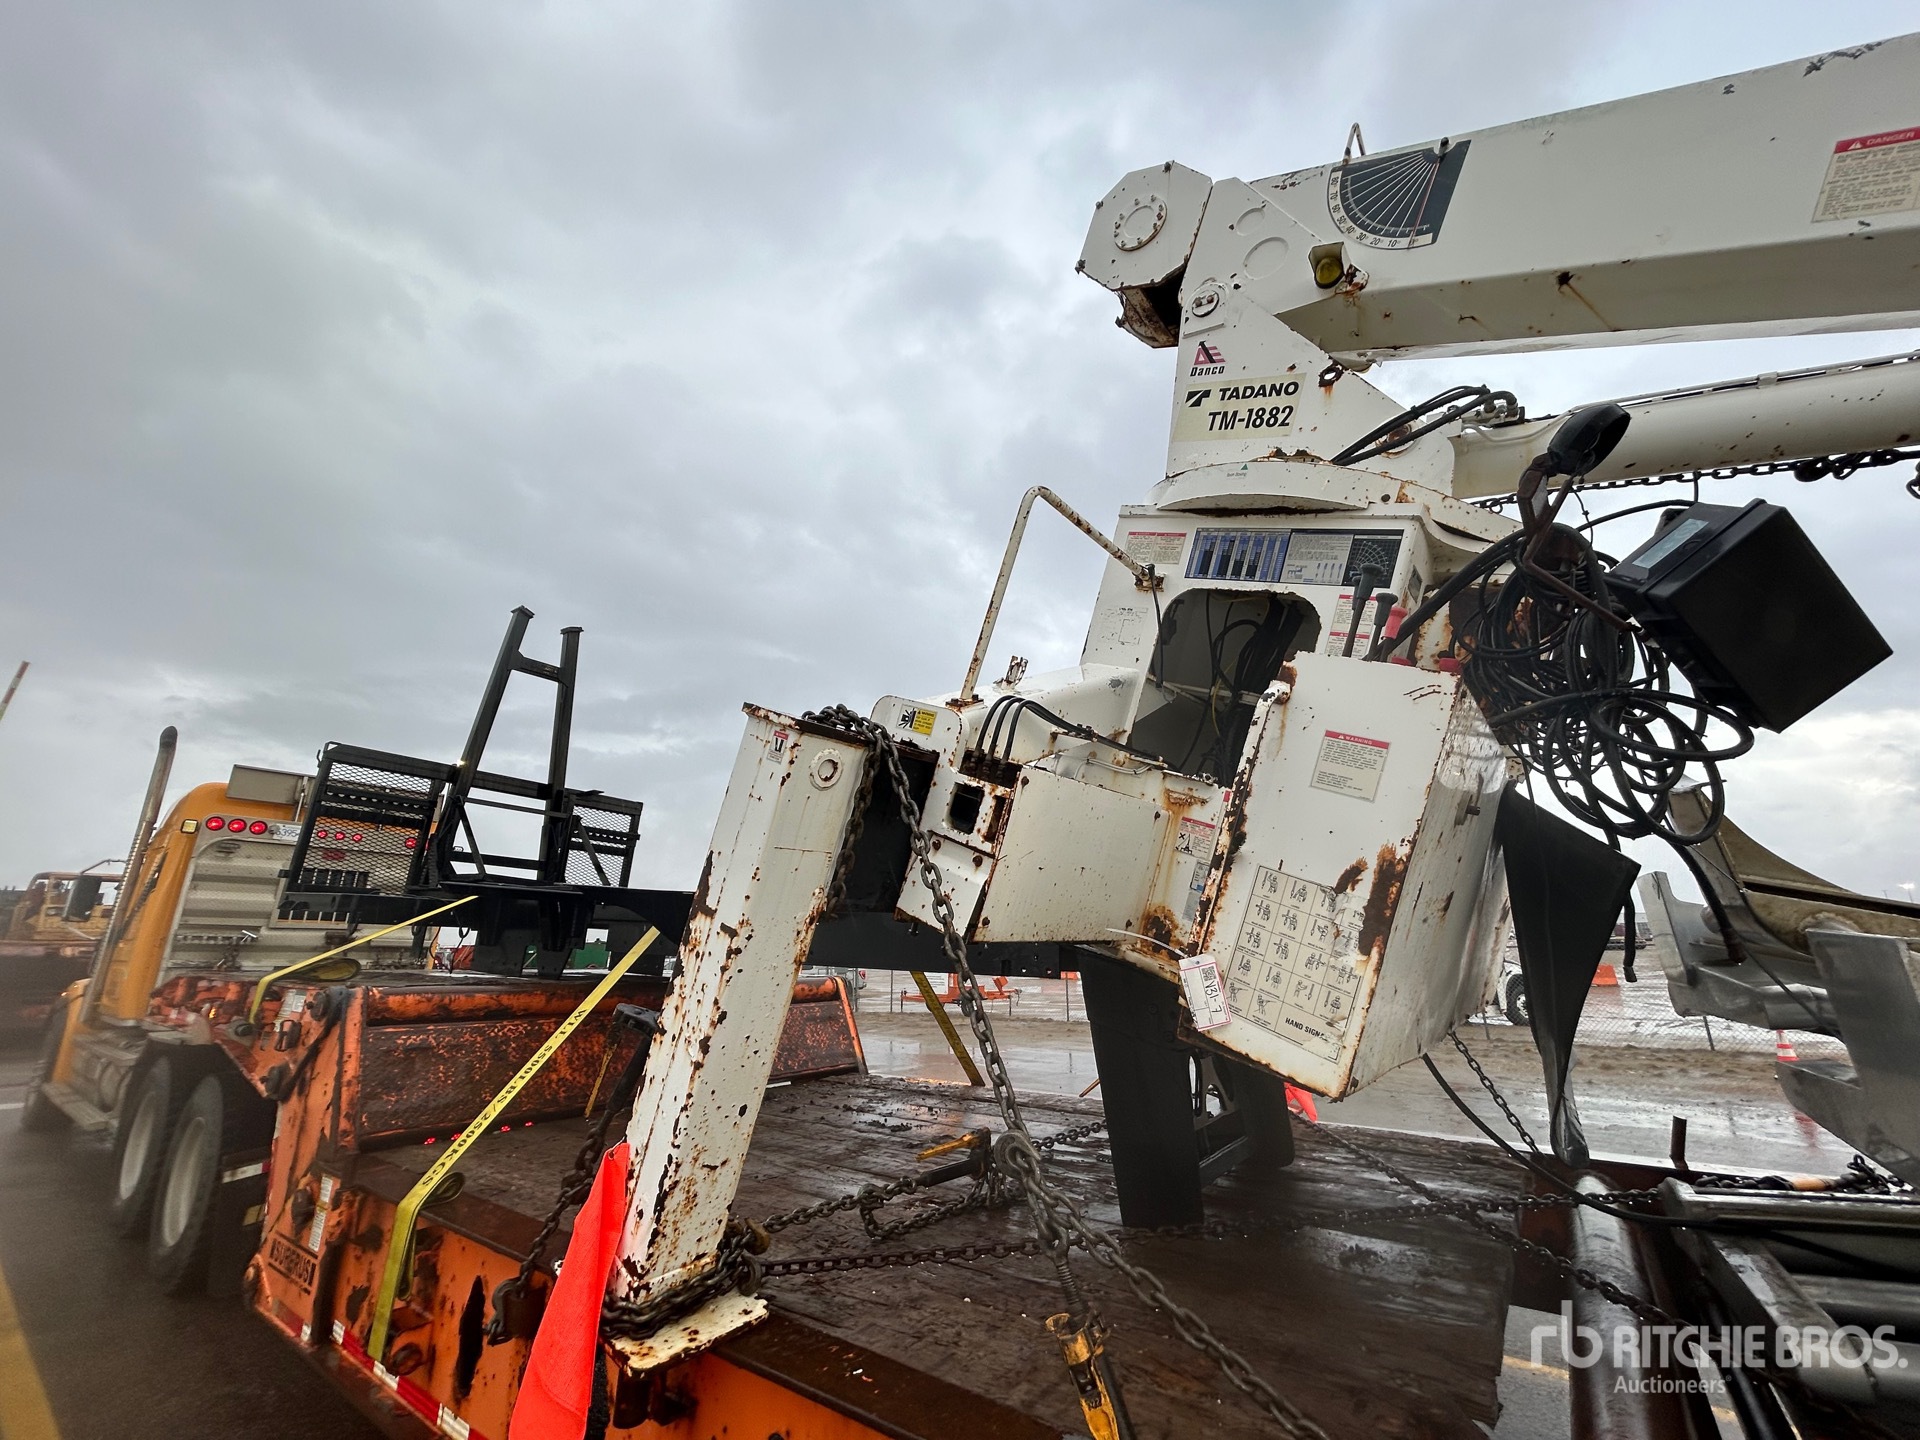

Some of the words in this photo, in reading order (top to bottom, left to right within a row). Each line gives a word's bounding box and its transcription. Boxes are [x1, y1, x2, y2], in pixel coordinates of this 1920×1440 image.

[1866, 131, 1916, 145] DANGER
[1190, 366, 1225, 377] Danco
[1219, 381, 1299, 402] TADANO
[1208, 405, 1294, 432] TM-1882
[1345, 735, 1373, 745] WARNING
[555, 1008, 588, 1039] WLL
[1285, 1017, 1303, 1031] HAND
